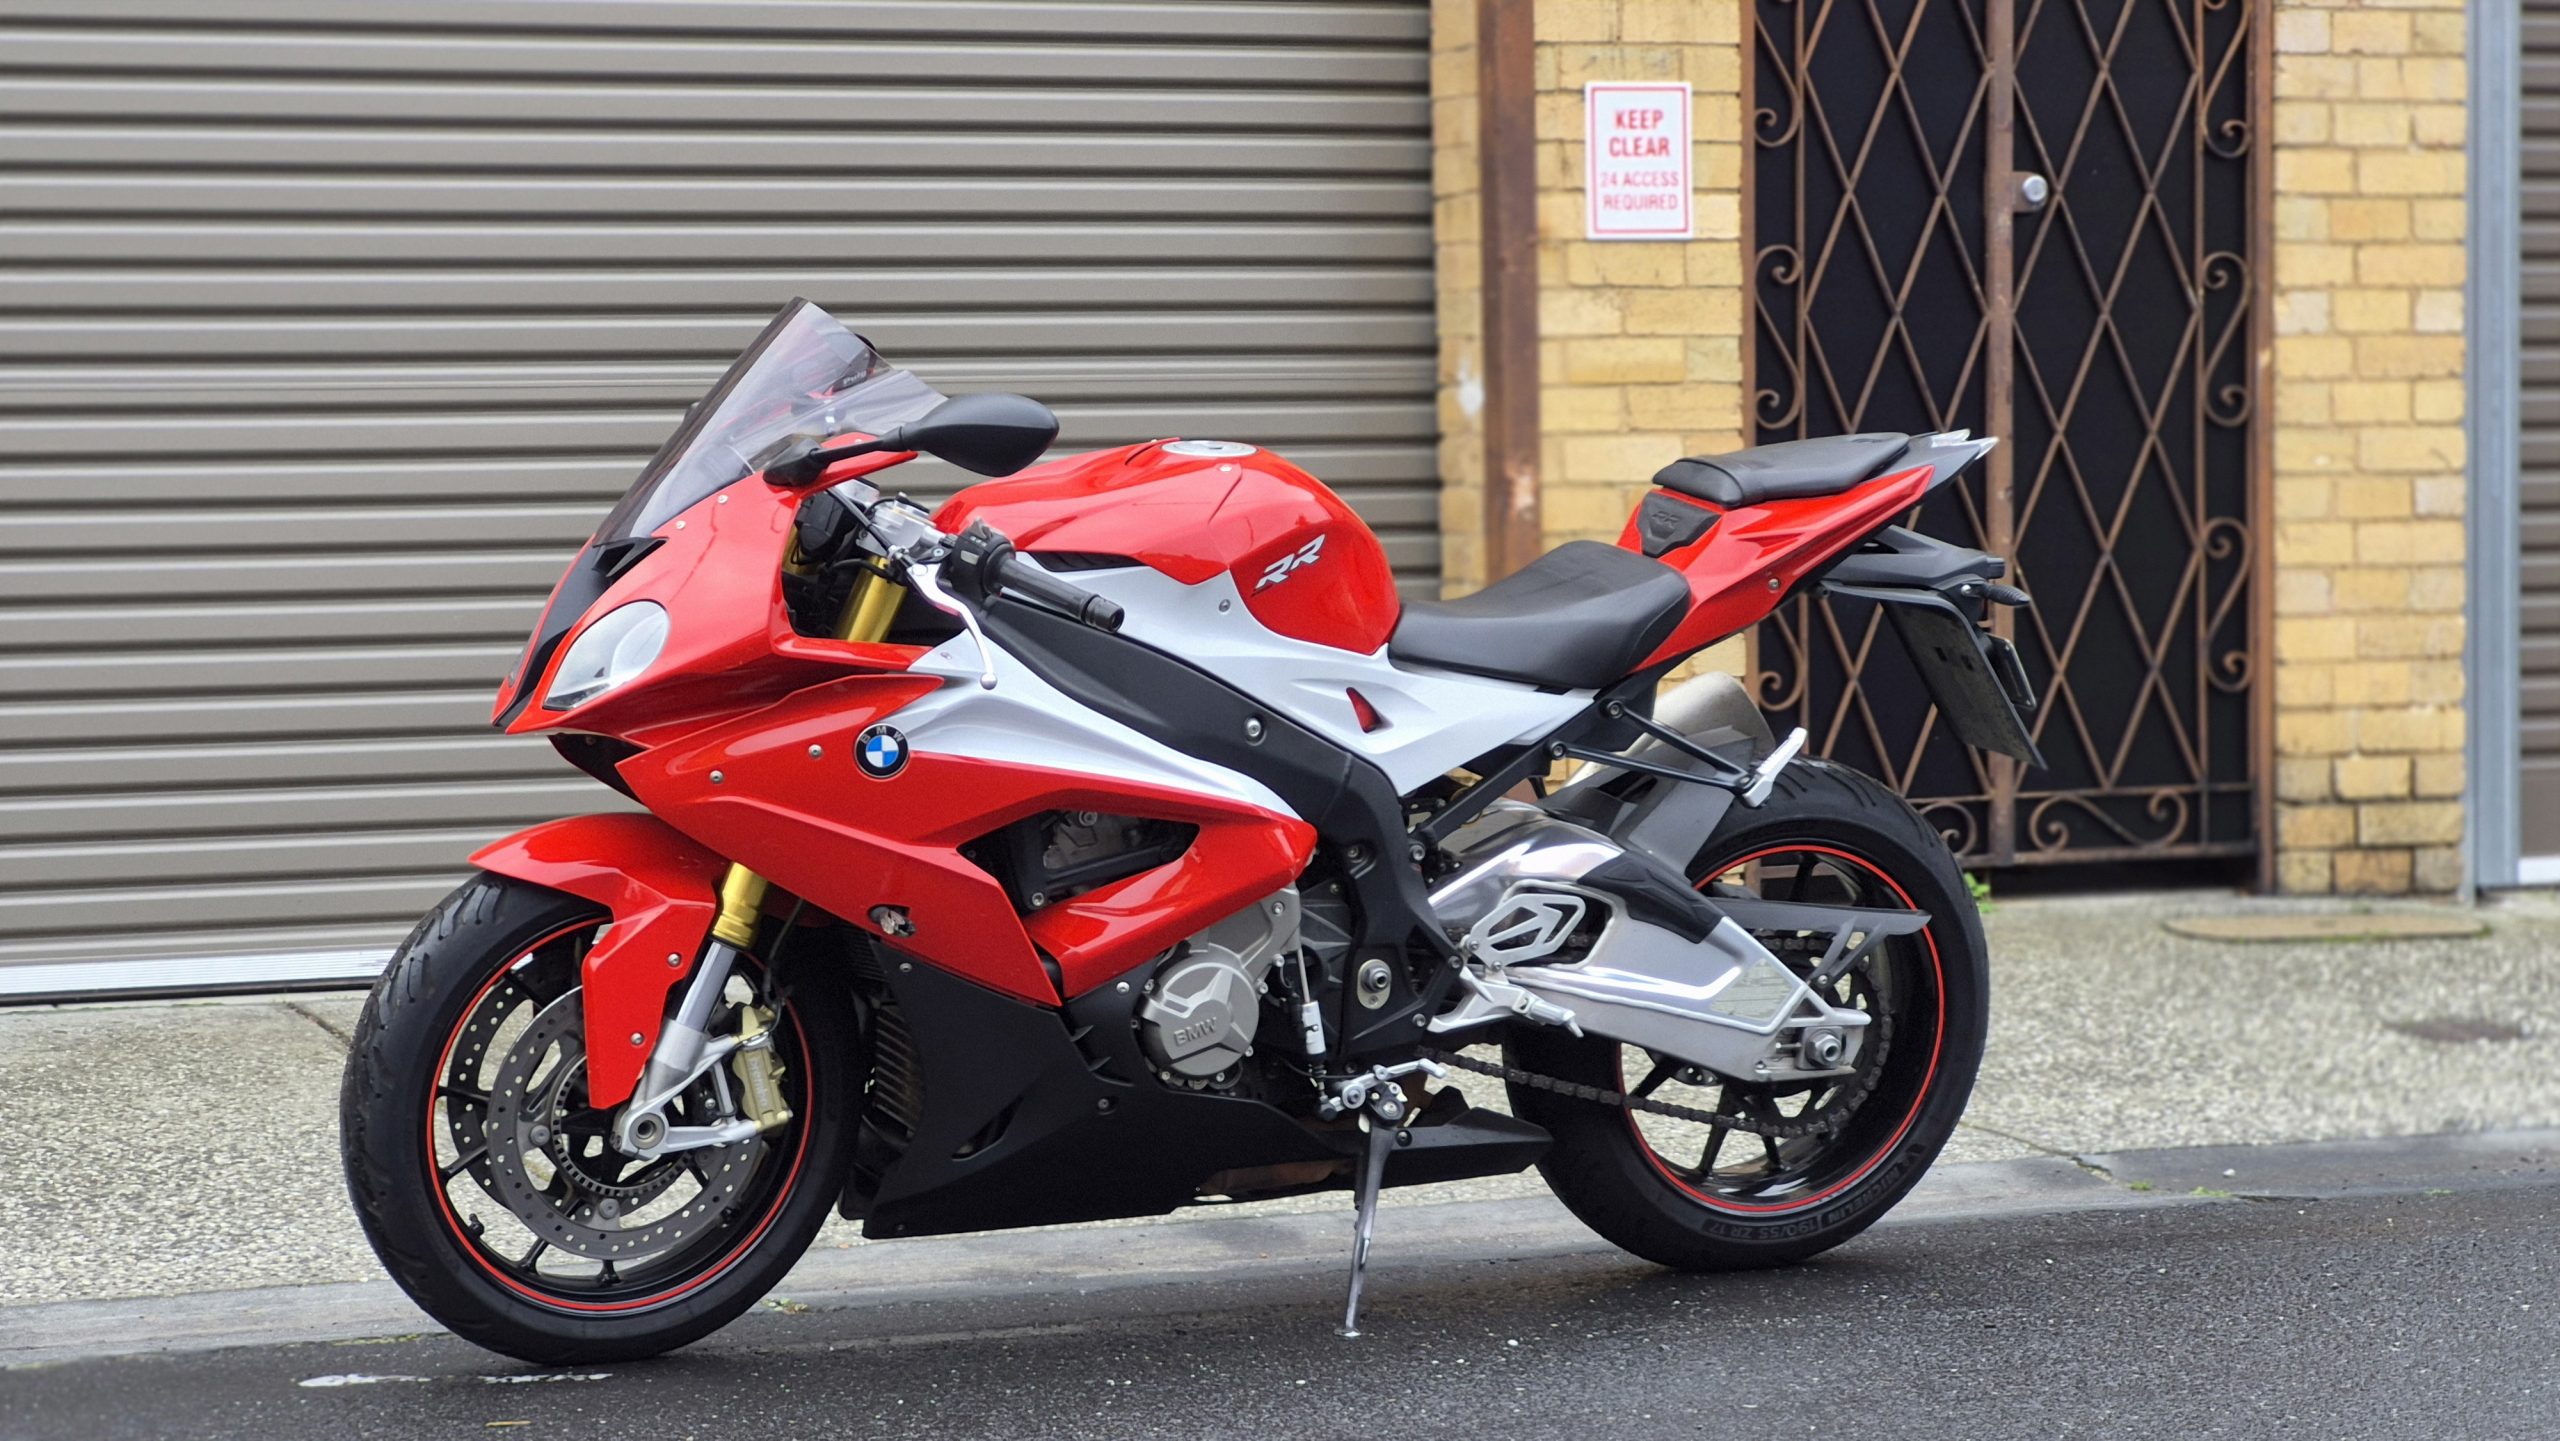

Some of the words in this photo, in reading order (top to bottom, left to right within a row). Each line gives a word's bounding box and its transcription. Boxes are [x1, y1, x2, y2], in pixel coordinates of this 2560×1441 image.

[1615, 110, 1664, 129] KEEP
[1608, 137, 1670, 157] CLEAR
[1600, 172, 1617, 188] 24
[1622, 171, 1679, 187] ACCESS
[1602, 194, 1678, 211] REQUIRED
[1650, 510, 1682, 530] RR
[1254, 533, 1326, 590] RR
[860, 726, 905, 744] BMW
[1174, 1016, 1217, 1046] BMW
[1827, 1167, 1899, 1223] MICHELIN
[1709, 1224, 1726, 1237] 17
[1730, 1226, 1753, 1239] ZR
[1759, 1218, 1818, 1239] 190/55
